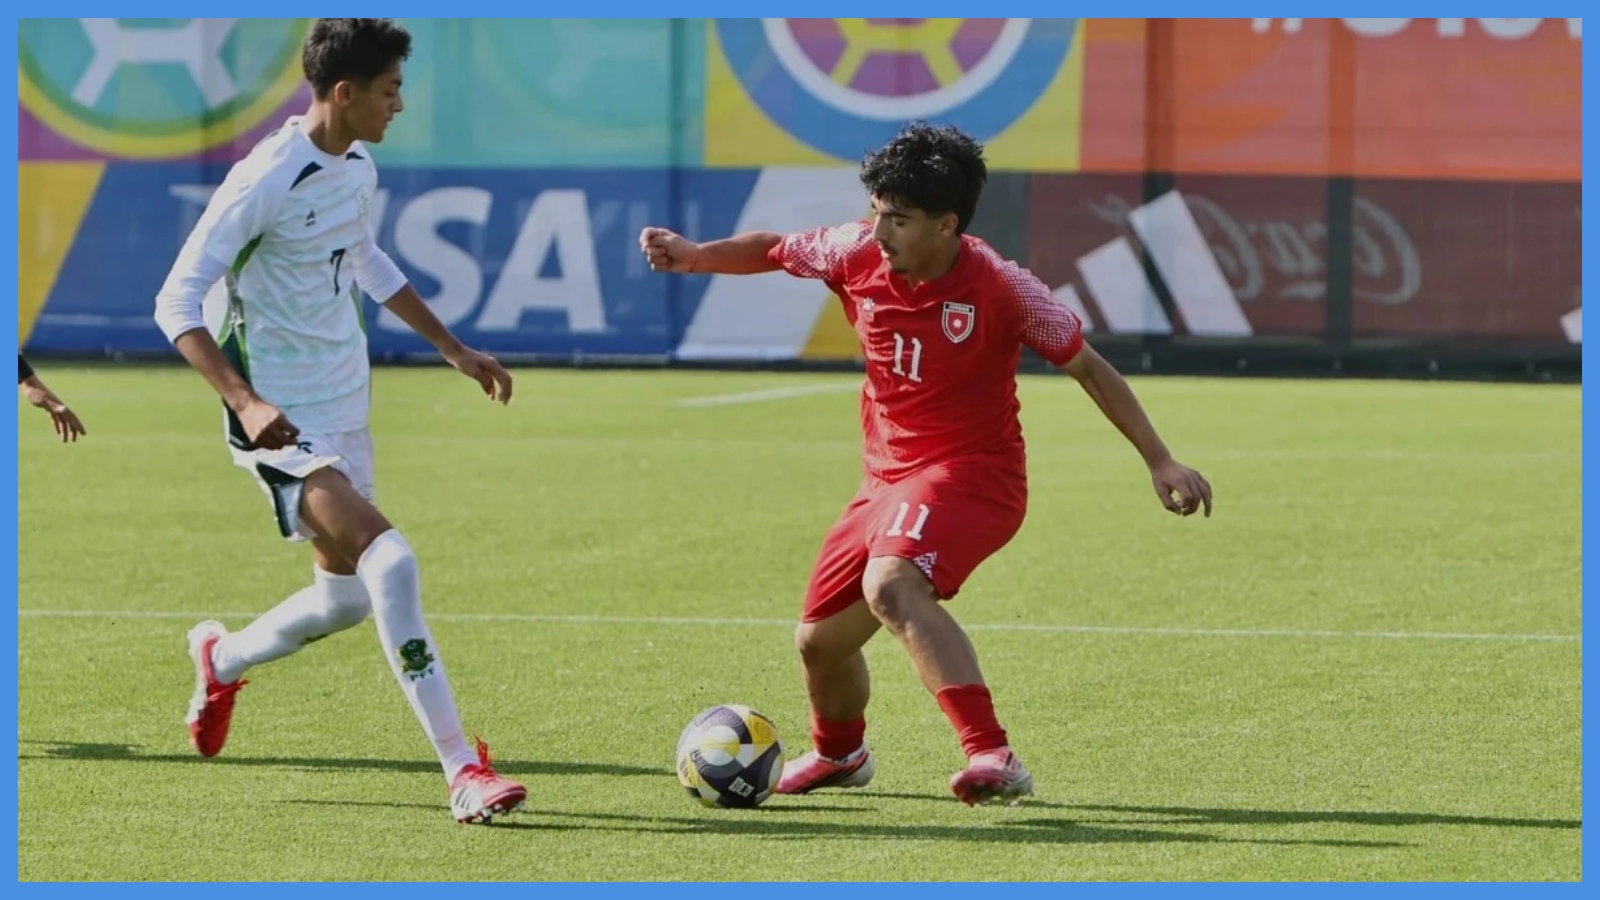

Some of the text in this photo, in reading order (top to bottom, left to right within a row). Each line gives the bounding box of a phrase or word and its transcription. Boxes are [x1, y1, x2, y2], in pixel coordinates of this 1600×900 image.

[168, 186, 607, 337] SA
[330, 248, 346, 296] 7
[892, 332, 922, 383] 11
[886, 502, 930, 541] 11
